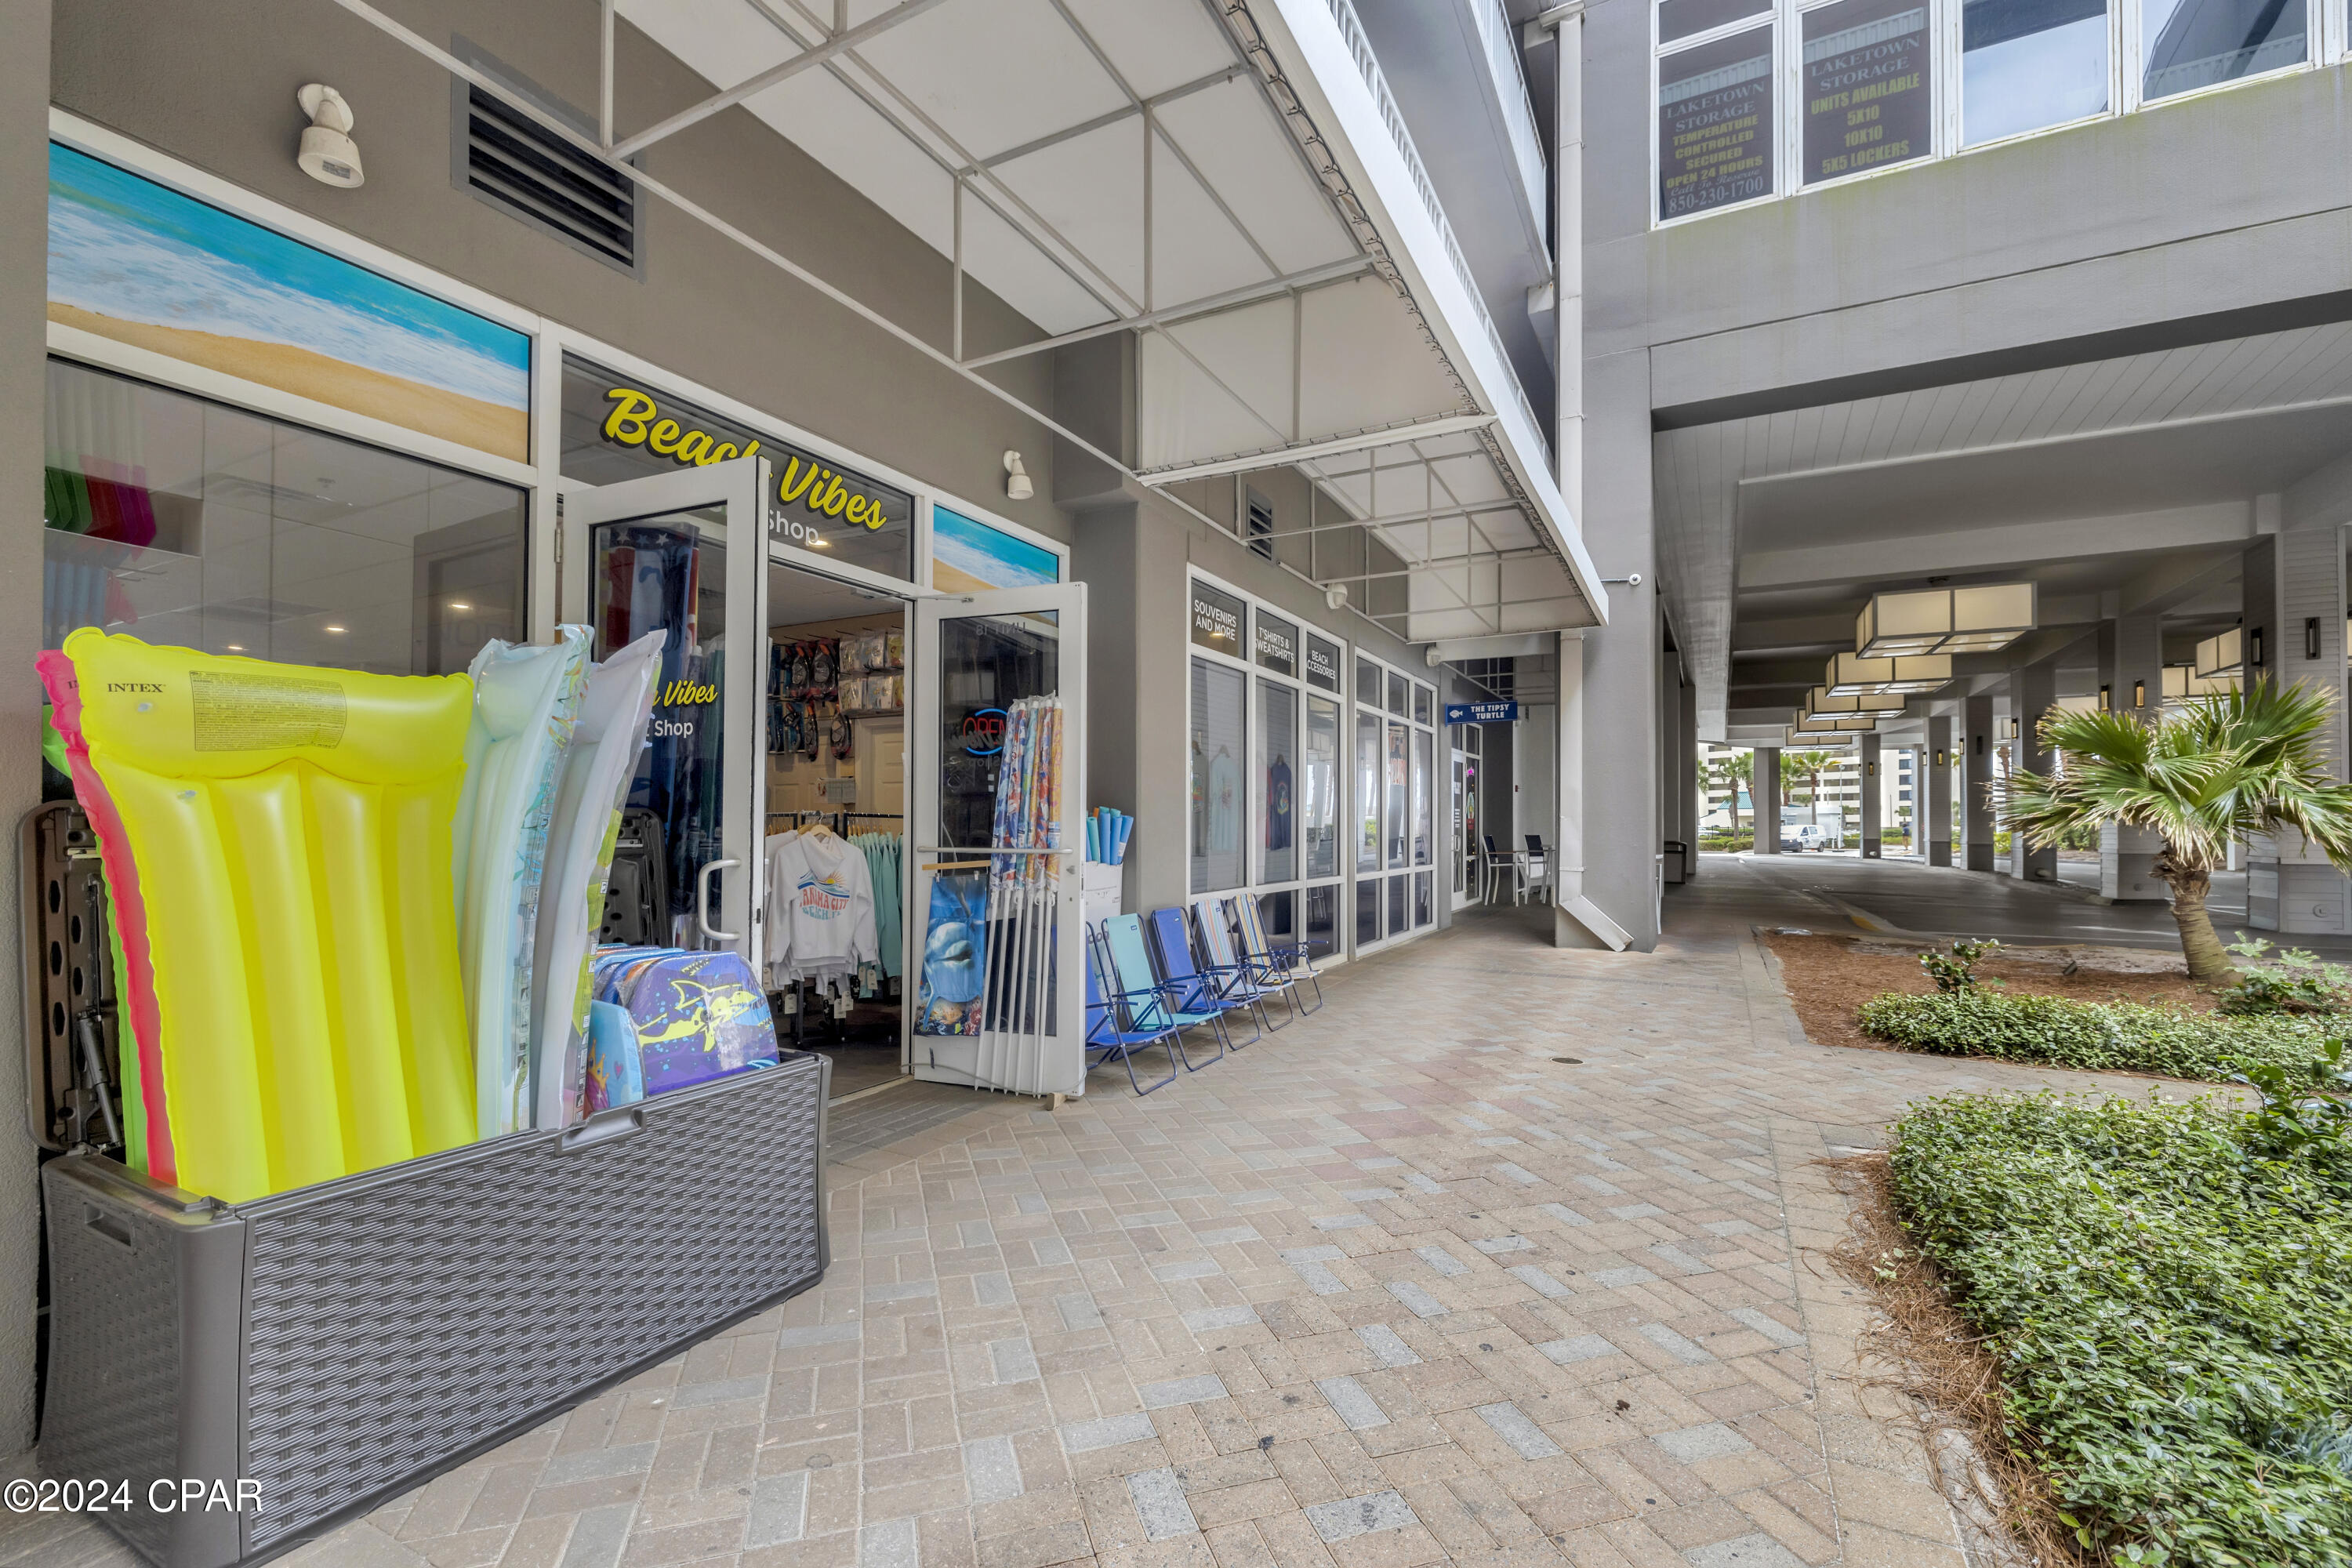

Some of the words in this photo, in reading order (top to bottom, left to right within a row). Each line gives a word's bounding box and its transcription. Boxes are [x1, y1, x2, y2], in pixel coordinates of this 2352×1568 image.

[1811, 35, 1920, 77] LAKETOWN
[1820, 56, 1909, 92] STORAGE
[1667, 81, 1764, 118] LAKETOWN
[1810, 92, 1849, 115] UNITS
[1851, 72, 1920, 104] AVAILABLE
[1675, 100, 1756, 132] STORAGE
[1846, 104, 1880, 126] 5X10
[1672, 114, 1759, 147] TEMPERATURE
[1675, 129, 1754, 159] CONTROLLED
[1844, 125, 1882, 147] 10X10
[1686, 147, 1743, 170] SECURED
[1822, 154, 1848, 175] 5X5
[1850, 140, 1910, 168] LOCKERS
[1666, 172, 1698, 189] OPEN
[1701, 167, 1716, 180] 24
[1719, 156, 1763, 176] HOURS
[1668, 176, 1763, 214] 850-230-1700
[1671, 184, 1694, 197] Call
[602, 388, 773, 479] Beac
[779, 456, 887, 530] Vibes
[1194, 599, 1236, 628] SOUVENIRS
[1196, 615, 1213, 632] AND
[1214, 622, 1236, 641] MORE
[1258, 626, 1284, 648] T'SHIRTS
[1285, 638, 1290, 649] &
[1307, 659, 1336, 680] CCESSORIES
[1312, 650, 1328, 666] BEACH
[107, 683, 163, 693] INTEX
[664, 679, 718, 706] Vibes
[655, 719, 693, 738] Shop
[831, 897, 849, 910] CITY
